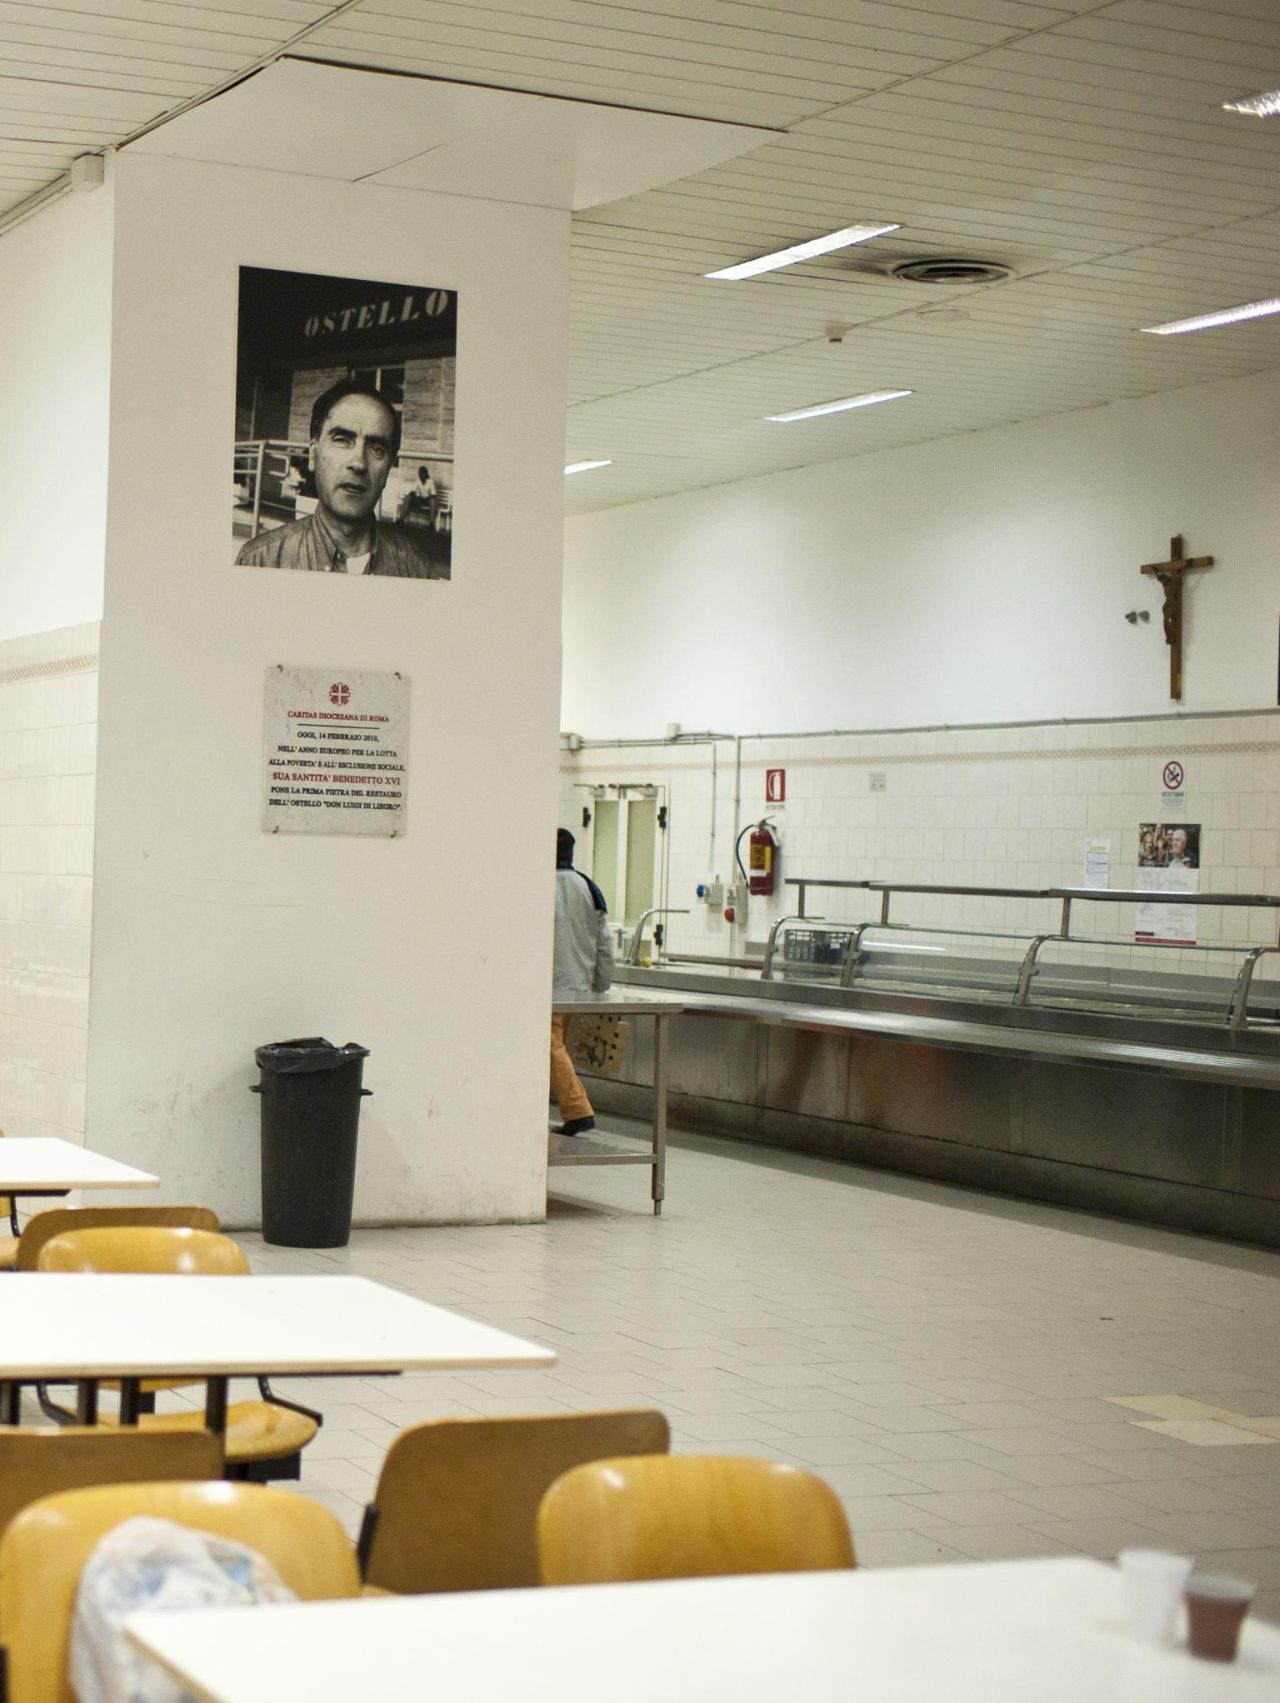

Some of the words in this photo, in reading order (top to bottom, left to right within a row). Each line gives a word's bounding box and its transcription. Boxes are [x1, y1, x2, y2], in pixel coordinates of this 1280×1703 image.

[304, 290, 449, 337] OSTELLO
[319, 713, 358, 721] DIOCESANA
[273, 772, 290, 780] SUA
[333, 775, 383, 784] BENEDETTO
[385, 777, 400, 785] XVI
